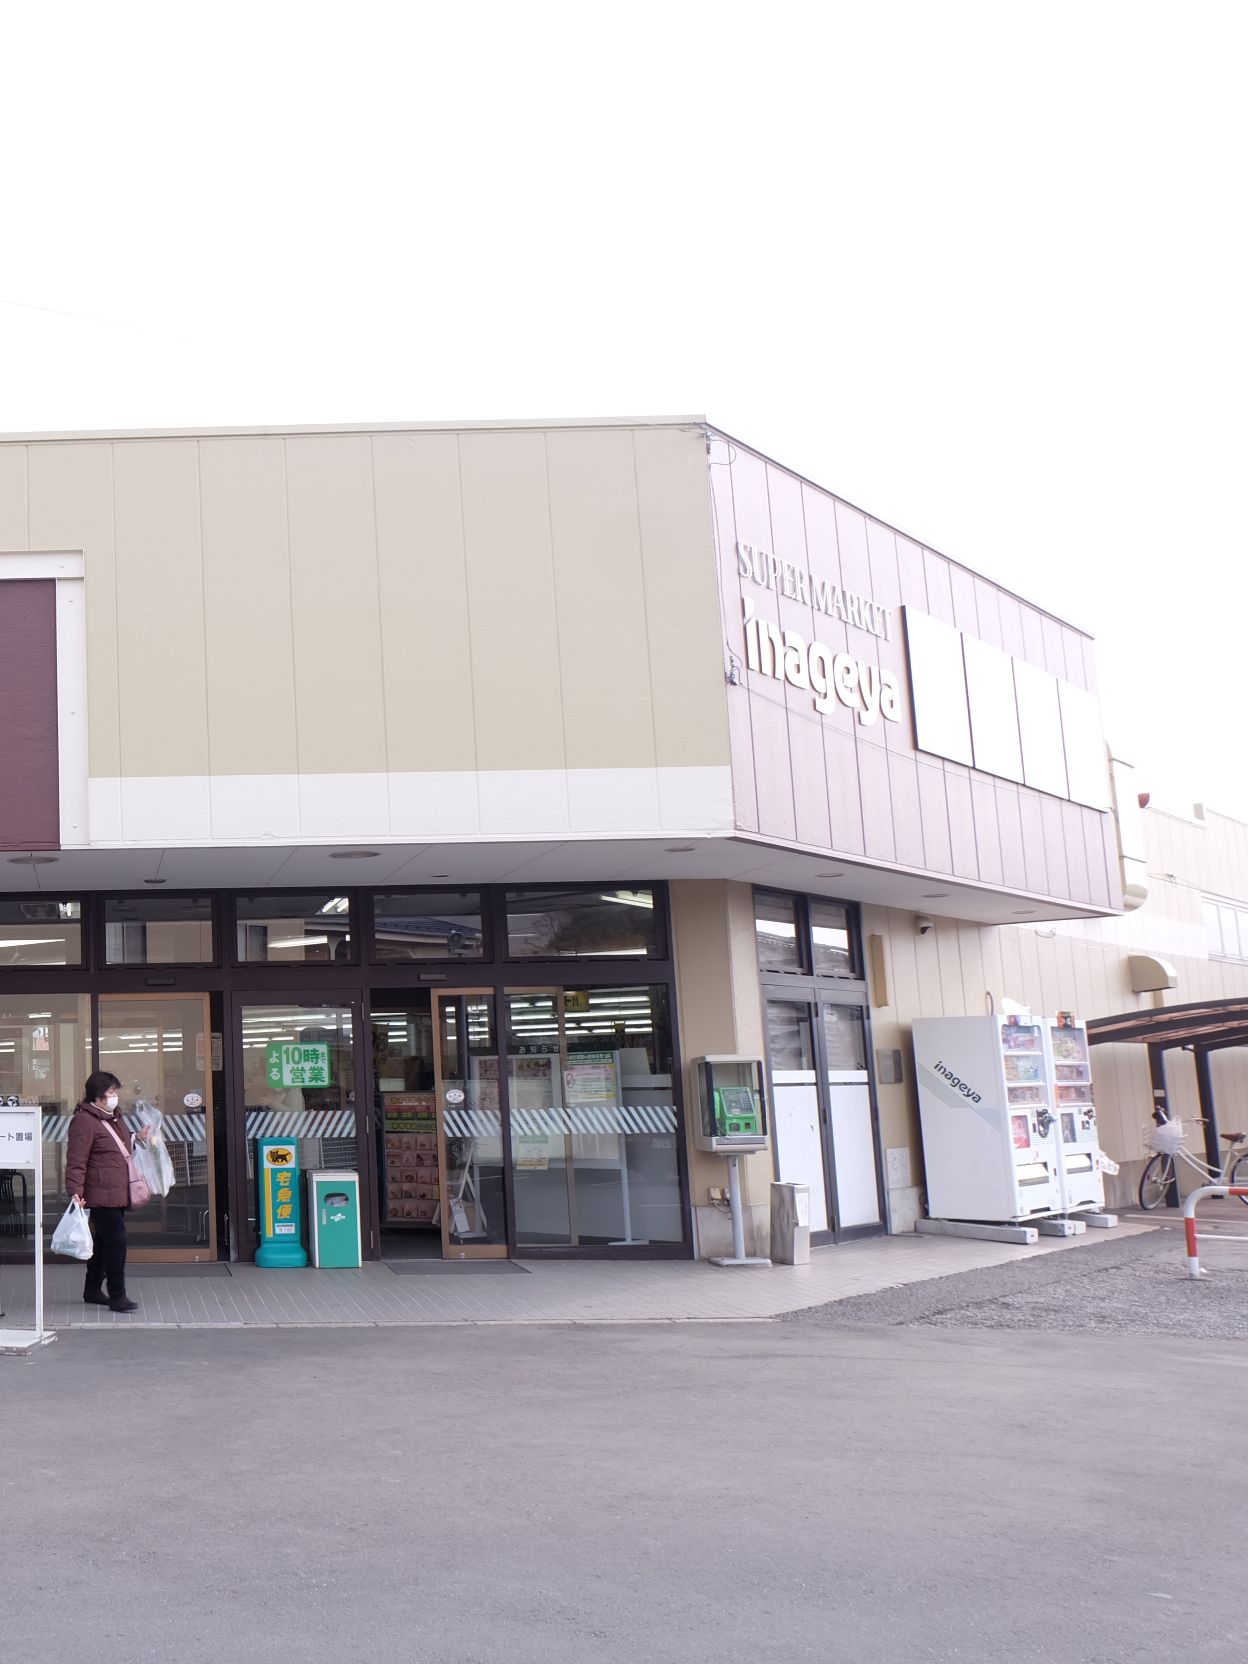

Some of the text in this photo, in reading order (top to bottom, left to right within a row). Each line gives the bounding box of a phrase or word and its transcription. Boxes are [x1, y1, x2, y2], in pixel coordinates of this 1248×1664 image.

[742, 597, 902, 727] inageya
[290, 1066, 326, 1084] 営業
[933, 1060, 982, 1104] inageya
[276, 1171, 292, 1219] 宅急便
